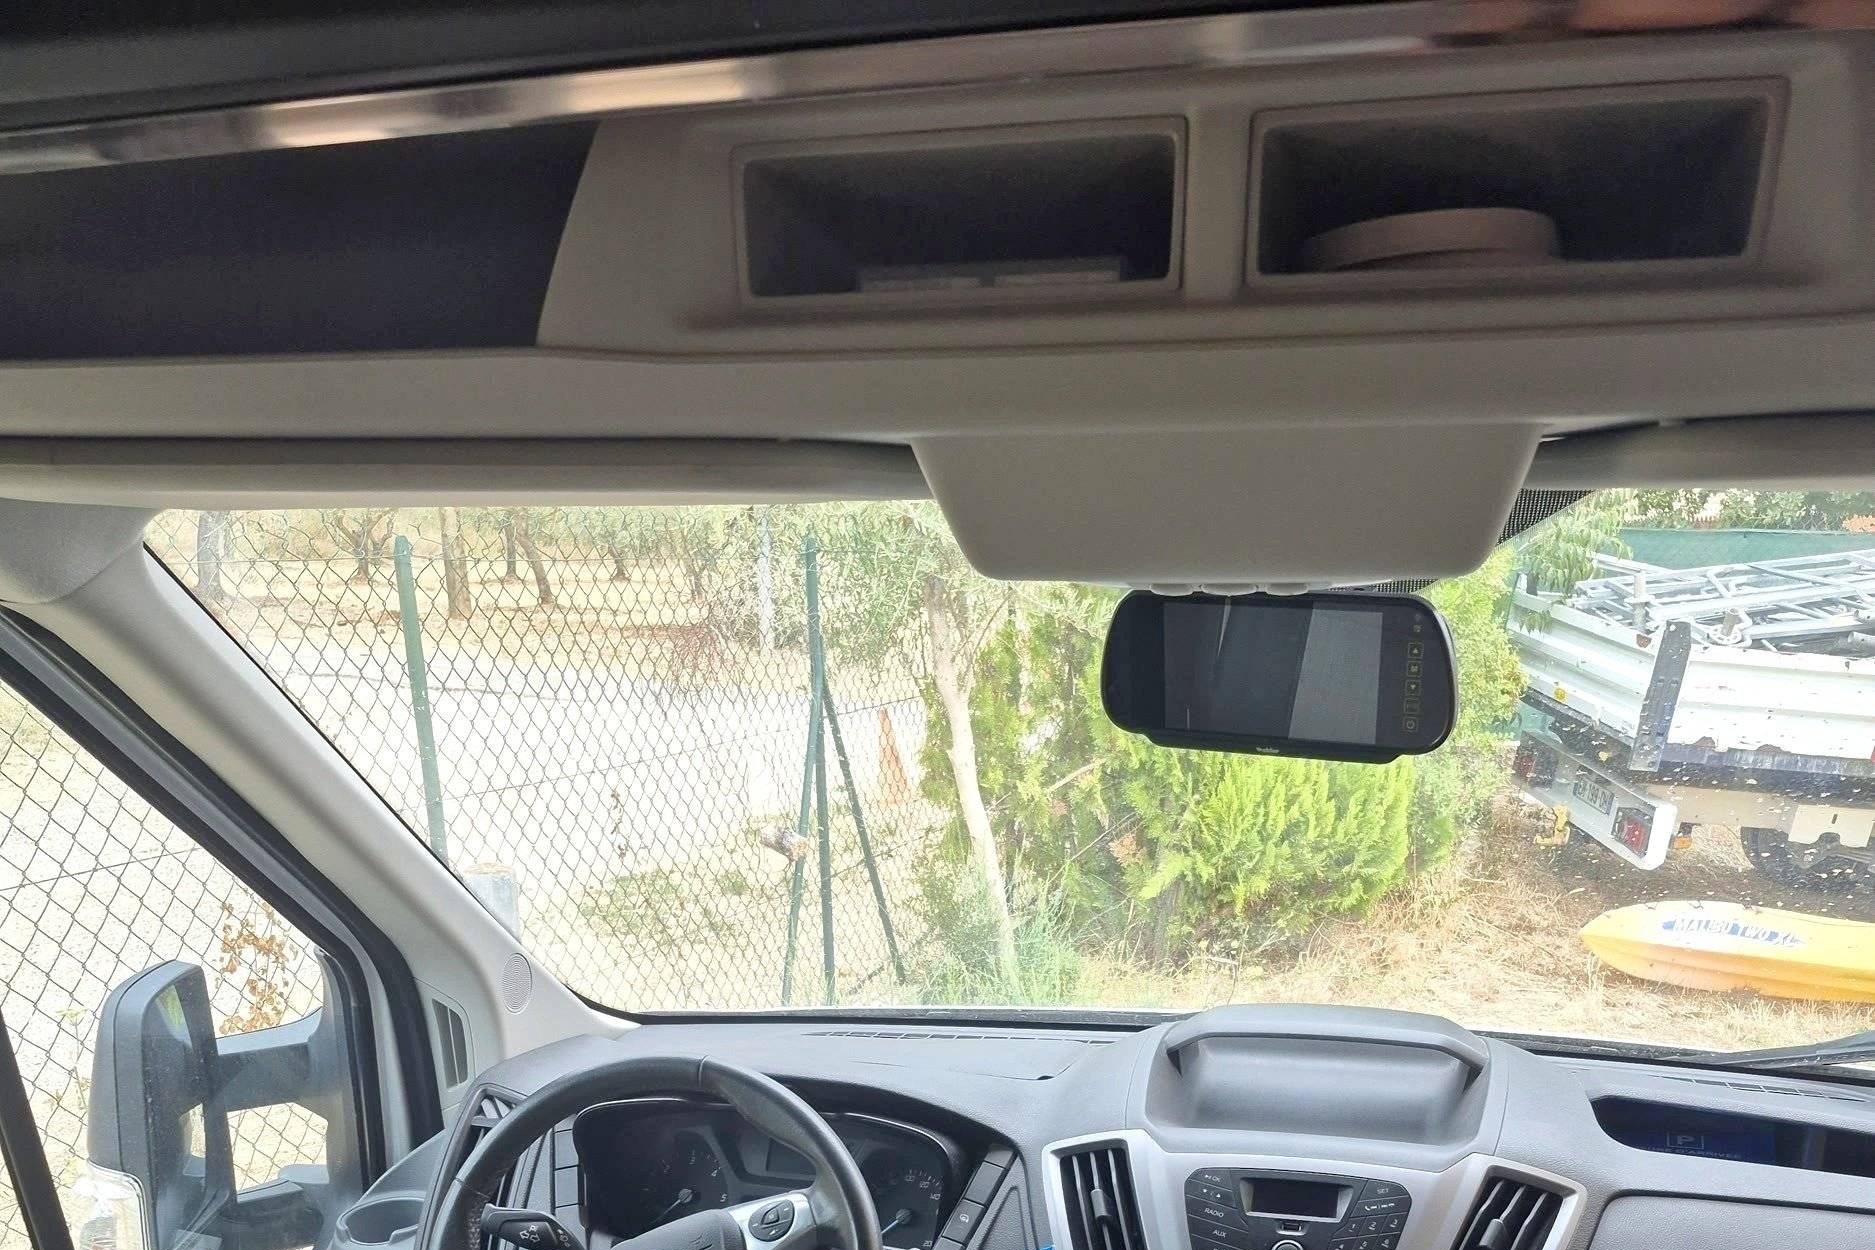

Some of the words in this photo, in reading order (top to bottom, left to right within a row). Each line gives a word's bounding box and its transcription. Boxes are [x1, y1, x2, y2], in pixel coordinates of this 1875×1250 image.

[1677, 1135, 1695, 1145] P
[1204, 1207, 1225, 1218] RADIO
[1212, 1229, 1228, 1238] AUX
